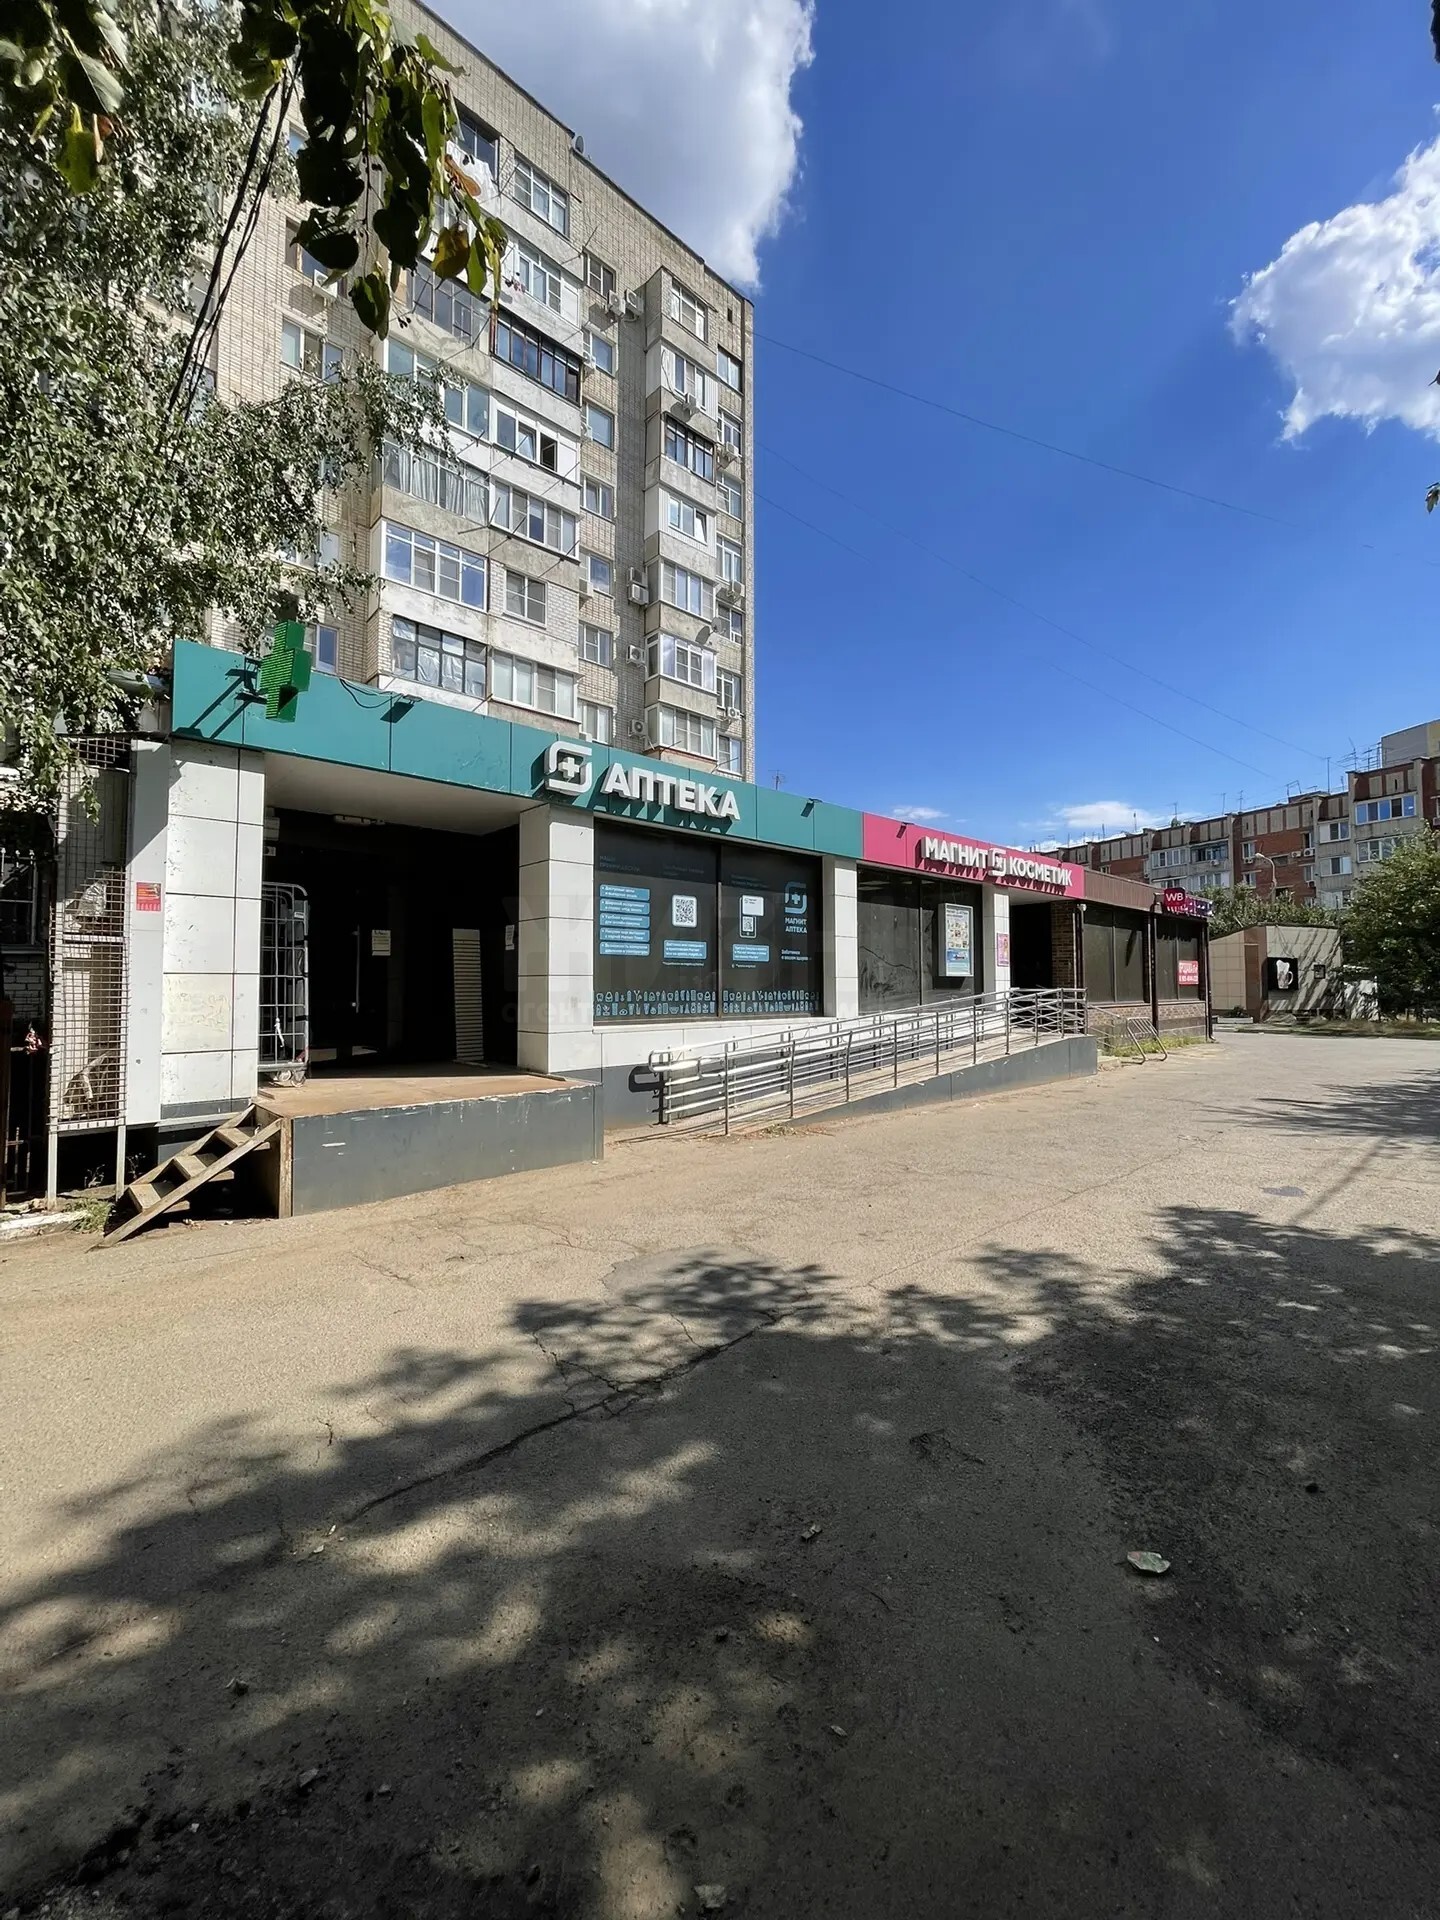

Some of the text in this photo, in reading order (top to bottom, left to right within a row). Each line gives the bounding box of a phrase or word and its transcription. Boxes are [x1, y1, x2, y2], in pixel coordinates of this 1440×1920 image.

[600, 763, 741, 820] АПТЕКА
[923, 836, 1073, 886] МАГНИТ КОСМЕТИК
[1165, 892, 1184, 902] WB
[785, 917, 808, 926] МАГНИТ
[785, 926, 808, 934] АПТЕКА
